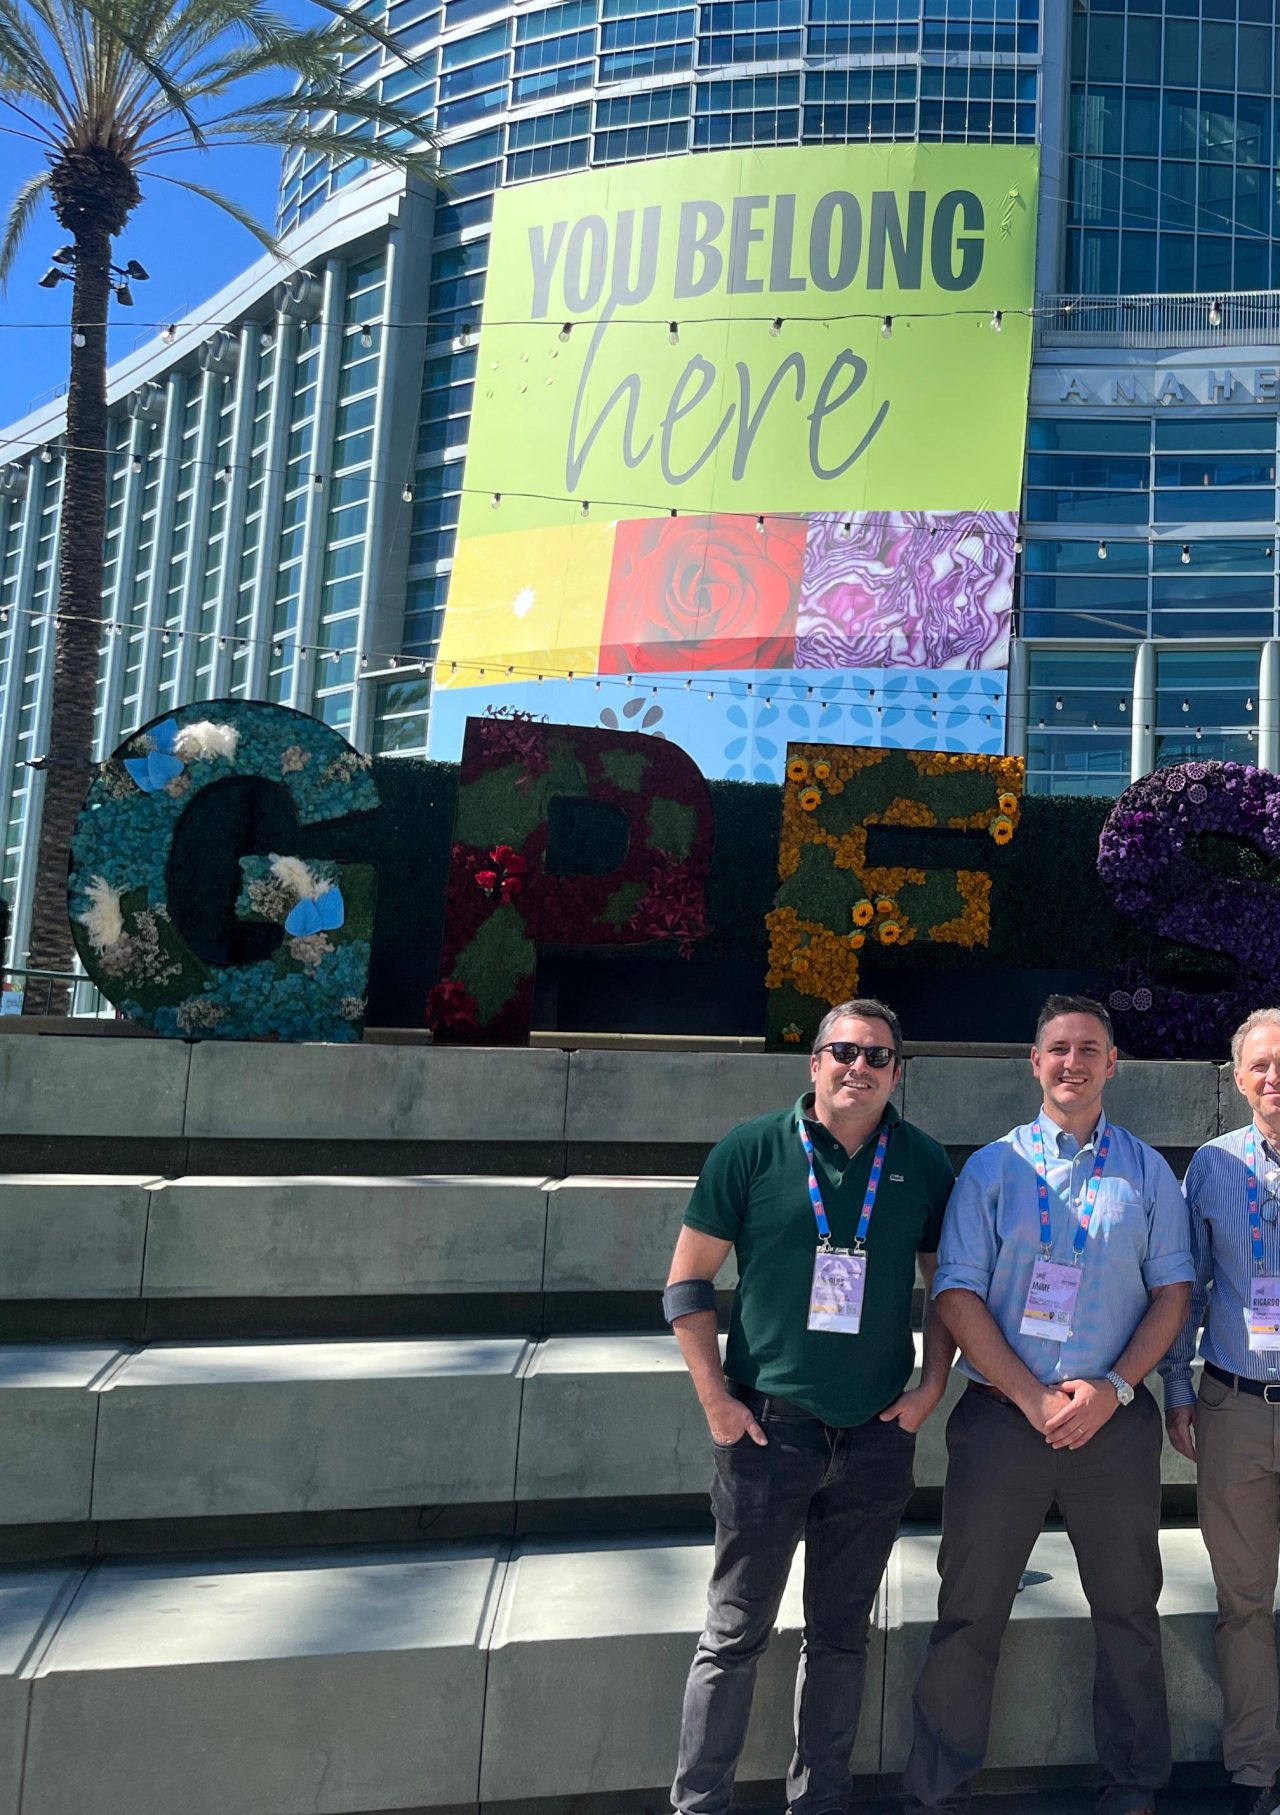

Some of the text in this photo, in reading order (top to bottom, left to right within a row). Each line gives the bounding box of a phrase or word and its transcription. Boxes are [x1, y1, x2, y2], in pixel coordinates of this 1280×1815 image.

[527, 189, 986, 319] YOU BELONG
[565, 297, 890, 493] here
[1253, 1298, 1280, 1307] RICARDO
